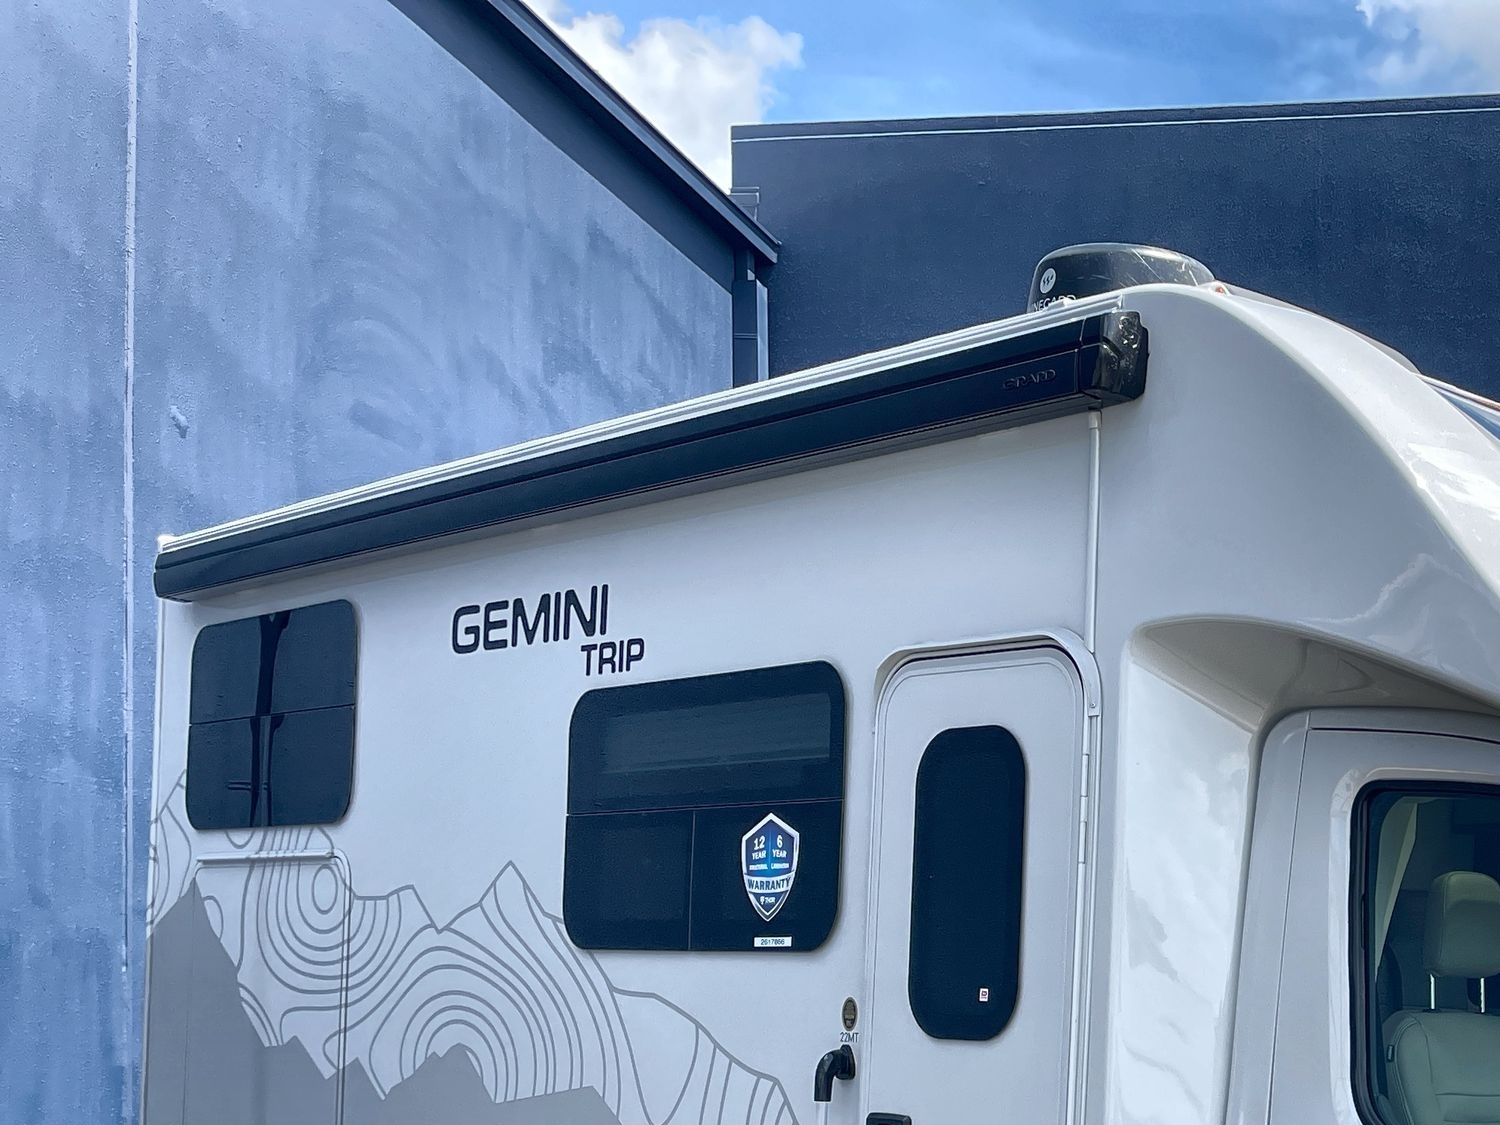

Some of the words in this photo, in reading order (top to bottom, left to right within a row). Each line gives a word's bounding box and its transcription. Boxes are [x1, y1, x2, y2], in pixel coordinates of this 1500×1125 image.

[452, 584, 609, 654] GEMINI
[580, 638, 645, 676] TRIP
[753, 835, 766, 850] 12
[776, 835, 783, 848] 6
[752, 850, 767, 860] YEAR
[772, 848, 787, 859] YEAR
[747, 877, 791, 891] WARRANTY
[839, 1031, 859, 1043] 22MT
